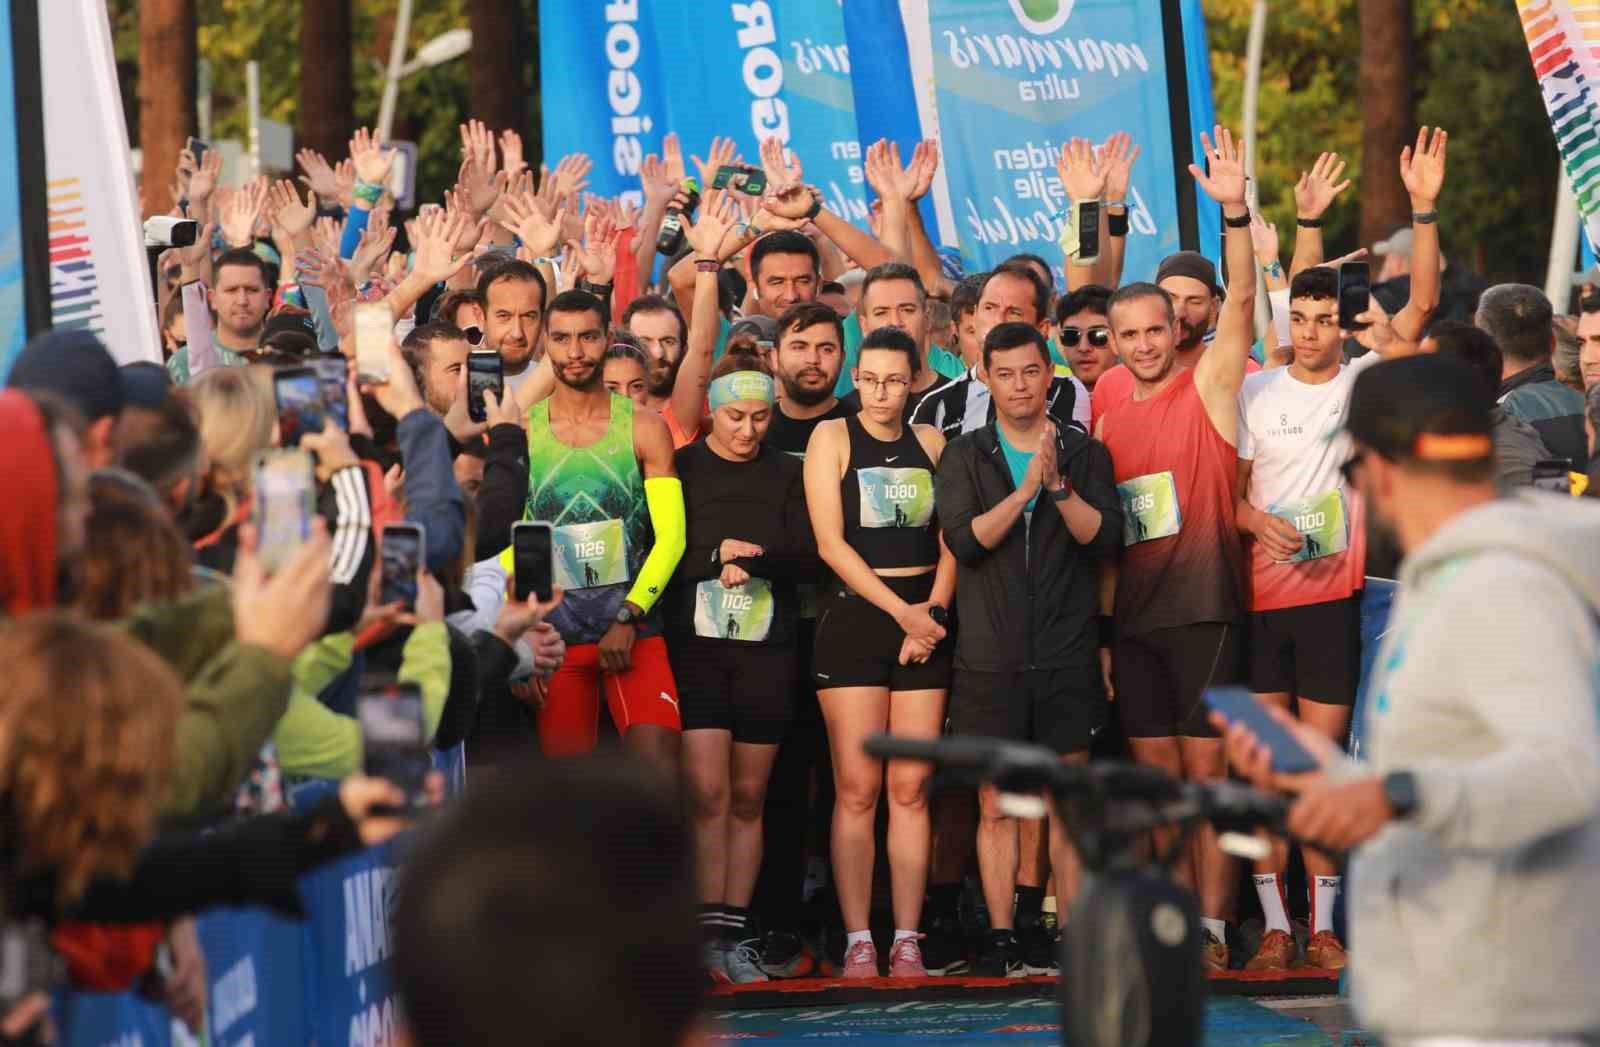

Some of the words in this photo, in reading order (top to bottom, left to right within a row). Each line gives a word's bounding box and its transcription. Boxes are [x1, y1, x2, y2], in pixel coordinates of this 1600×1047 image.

[884, 484, 917, 499] 1080
[1294, 511, 1326, 531] 1100
[574, 540, 606, 558] 1126
[721, 592, 753, 610] 1102
